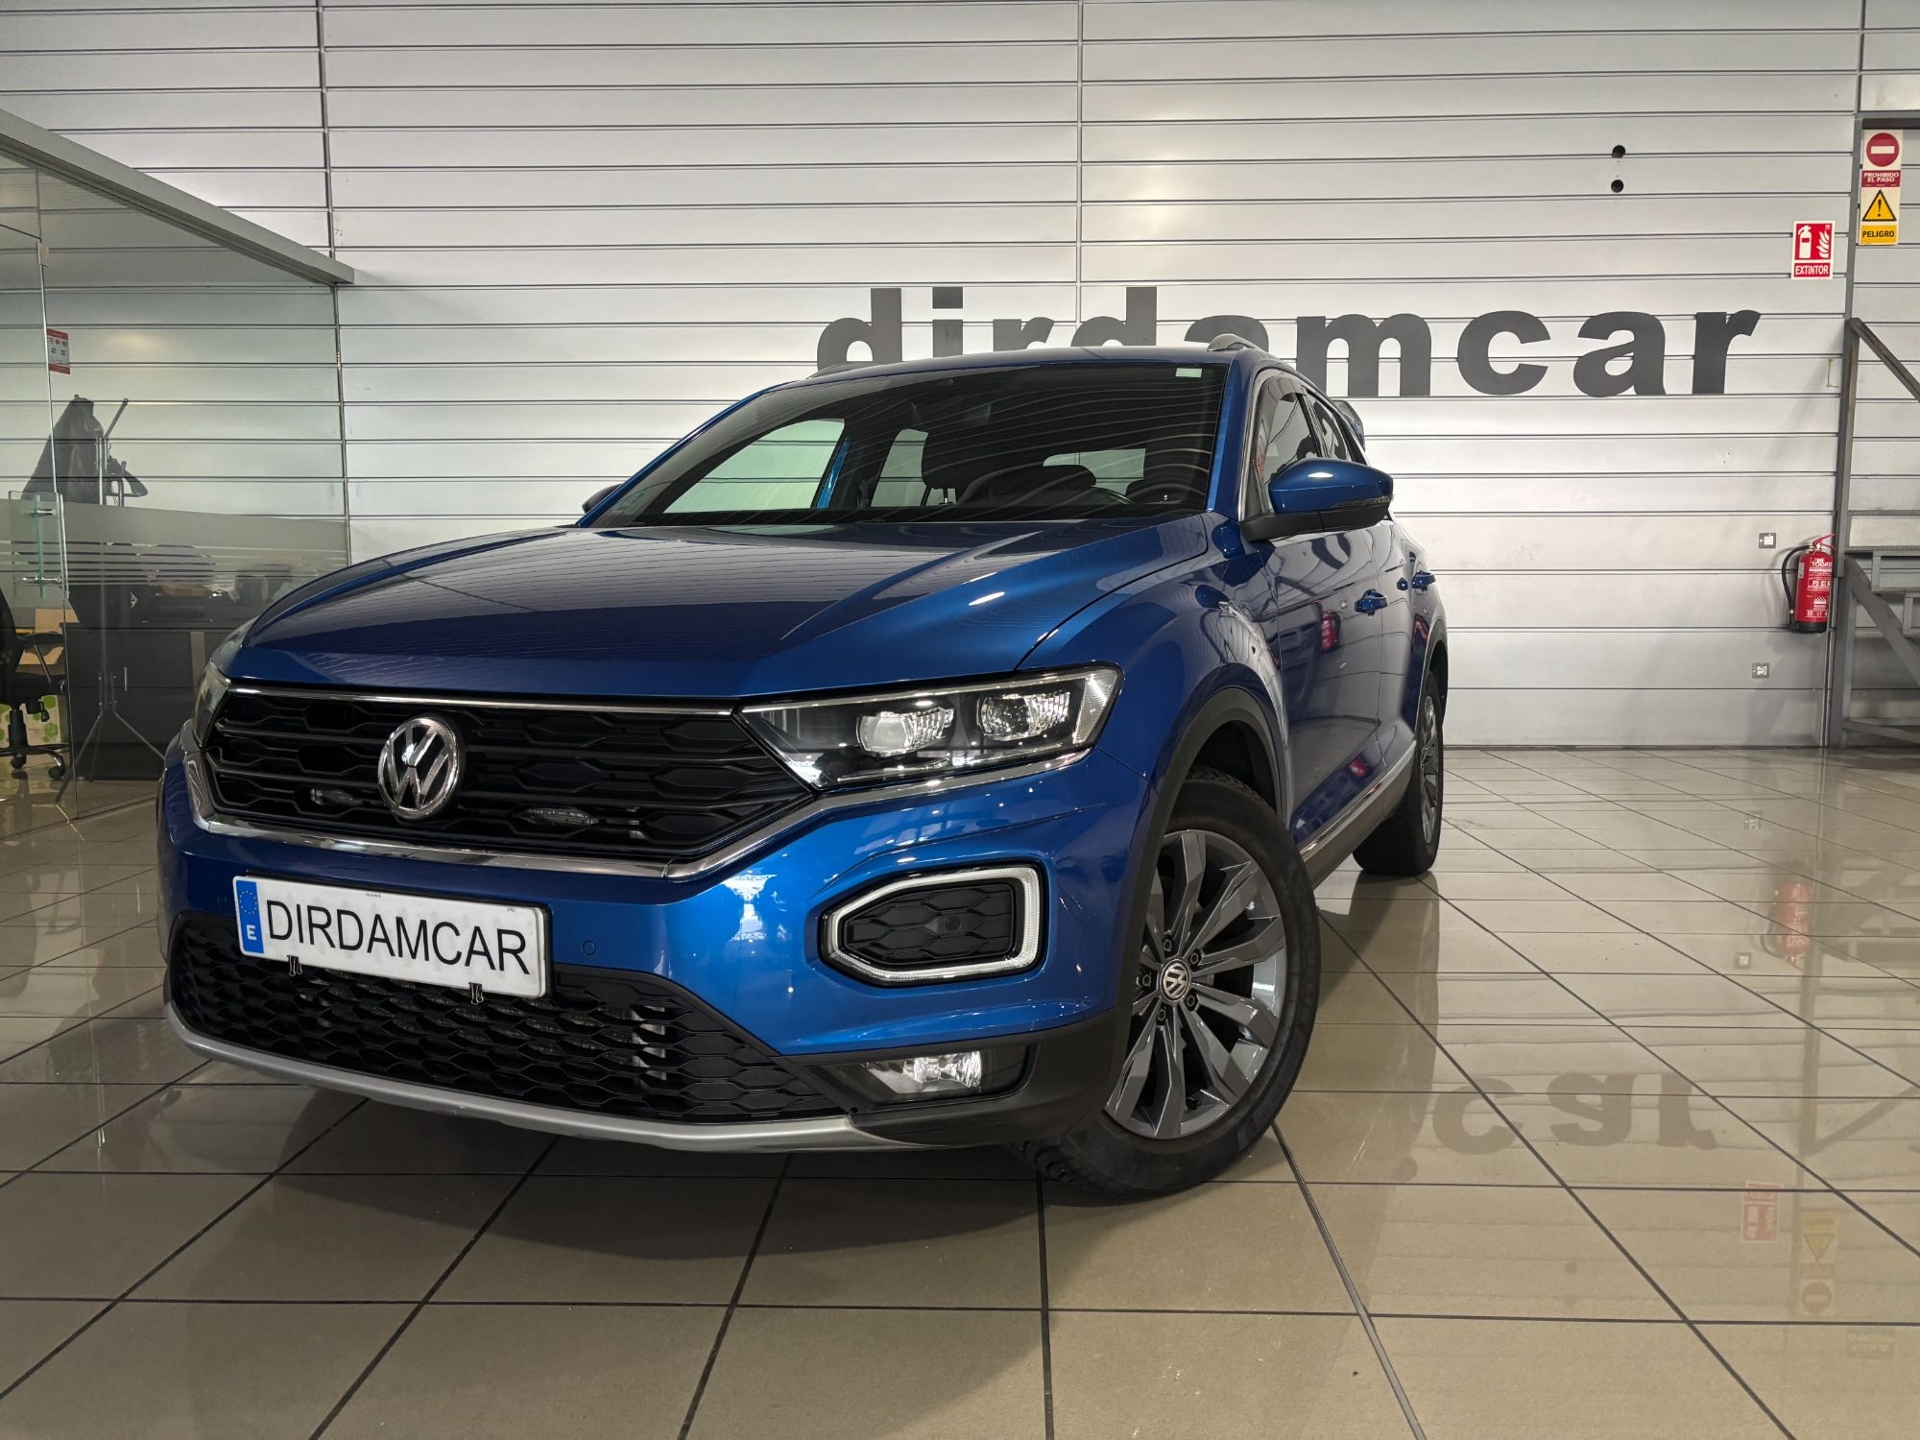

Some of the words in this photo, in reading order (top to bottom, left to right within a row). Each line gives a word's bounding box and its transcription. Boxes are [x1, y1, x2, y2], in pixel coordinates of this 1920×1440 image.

[1862, 230, 1895, 238] PELIGRO
[1795, 265, 1829, 275] EXTINTOR
[246, 924, 257, 941] E
[266, 899, 531, 976] DIRDAMCAR
